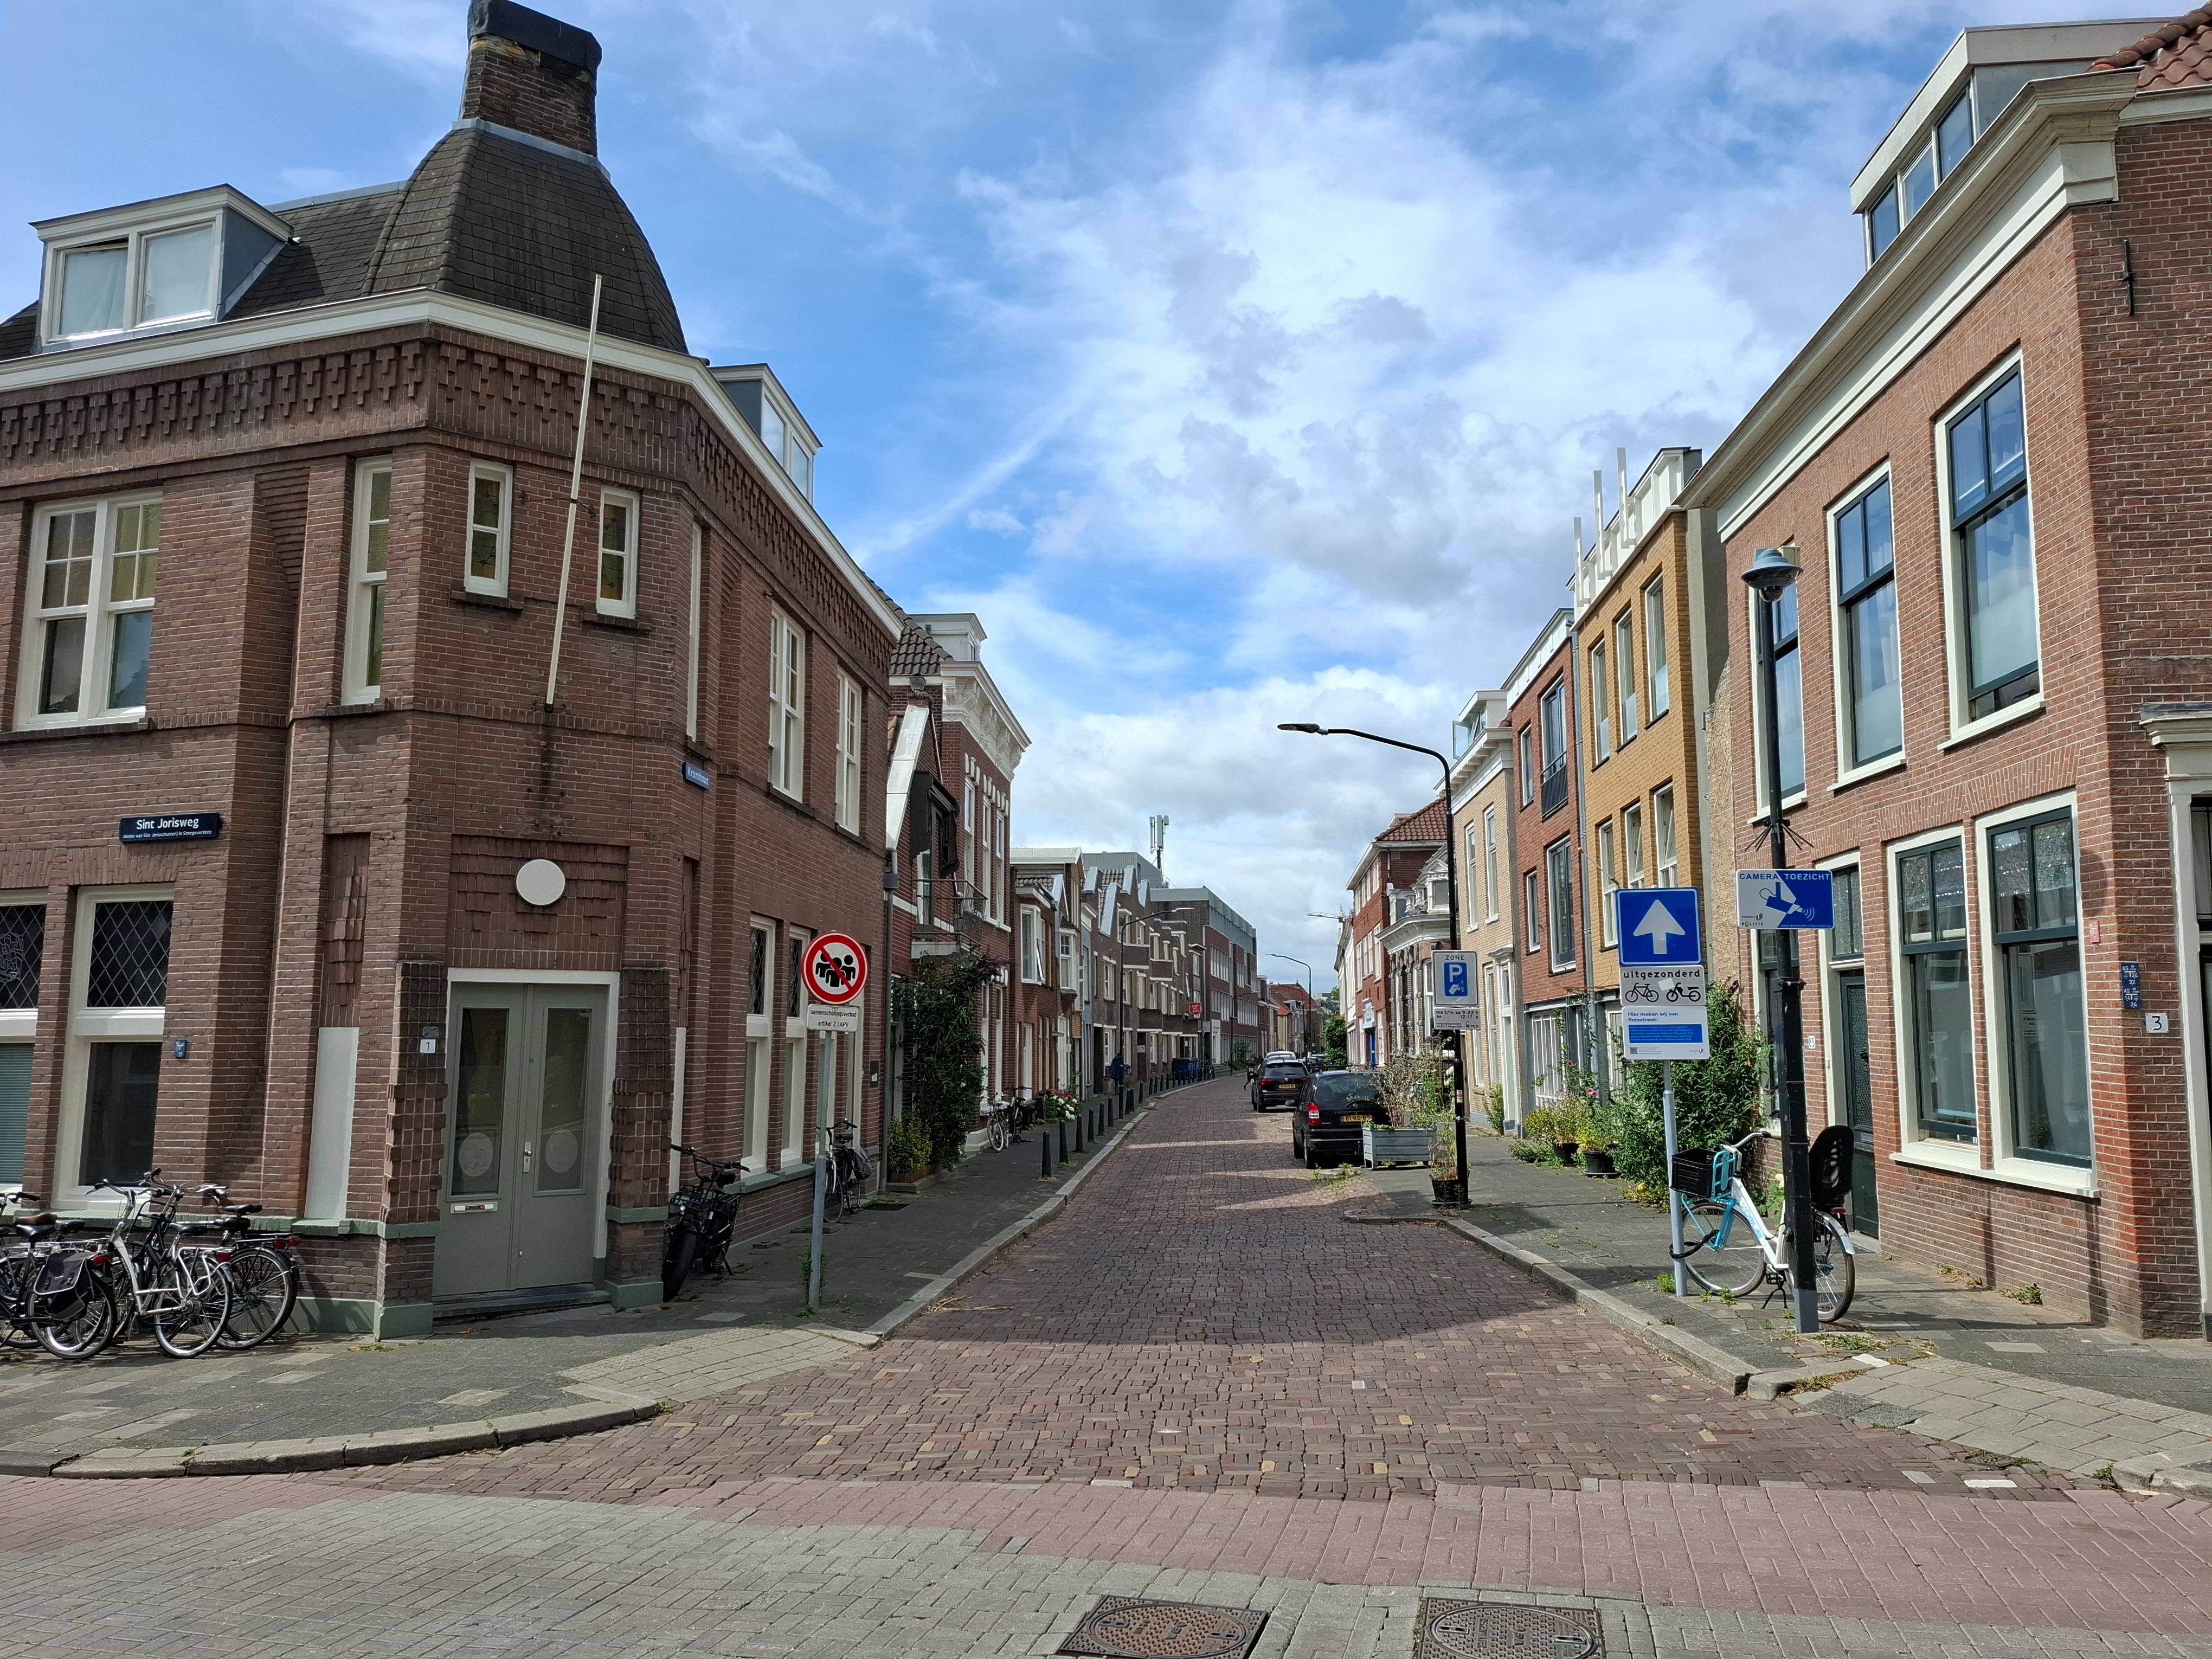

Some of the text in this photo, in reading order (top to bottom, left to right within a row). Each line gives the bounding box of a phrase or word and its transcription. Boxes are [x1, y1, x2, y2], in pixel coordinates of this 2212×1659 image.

[136, 818, 199, 829] Sint Jorisweg
[1449, 964, 1463, 982] P
[1623, 969, 1700, 980] uitgezonderd
[2151, 1015, 2162, 1031] 3
[425, 1041, 430, 1051] 1
[1741, 1201, 1763, 1239] VOGUE
